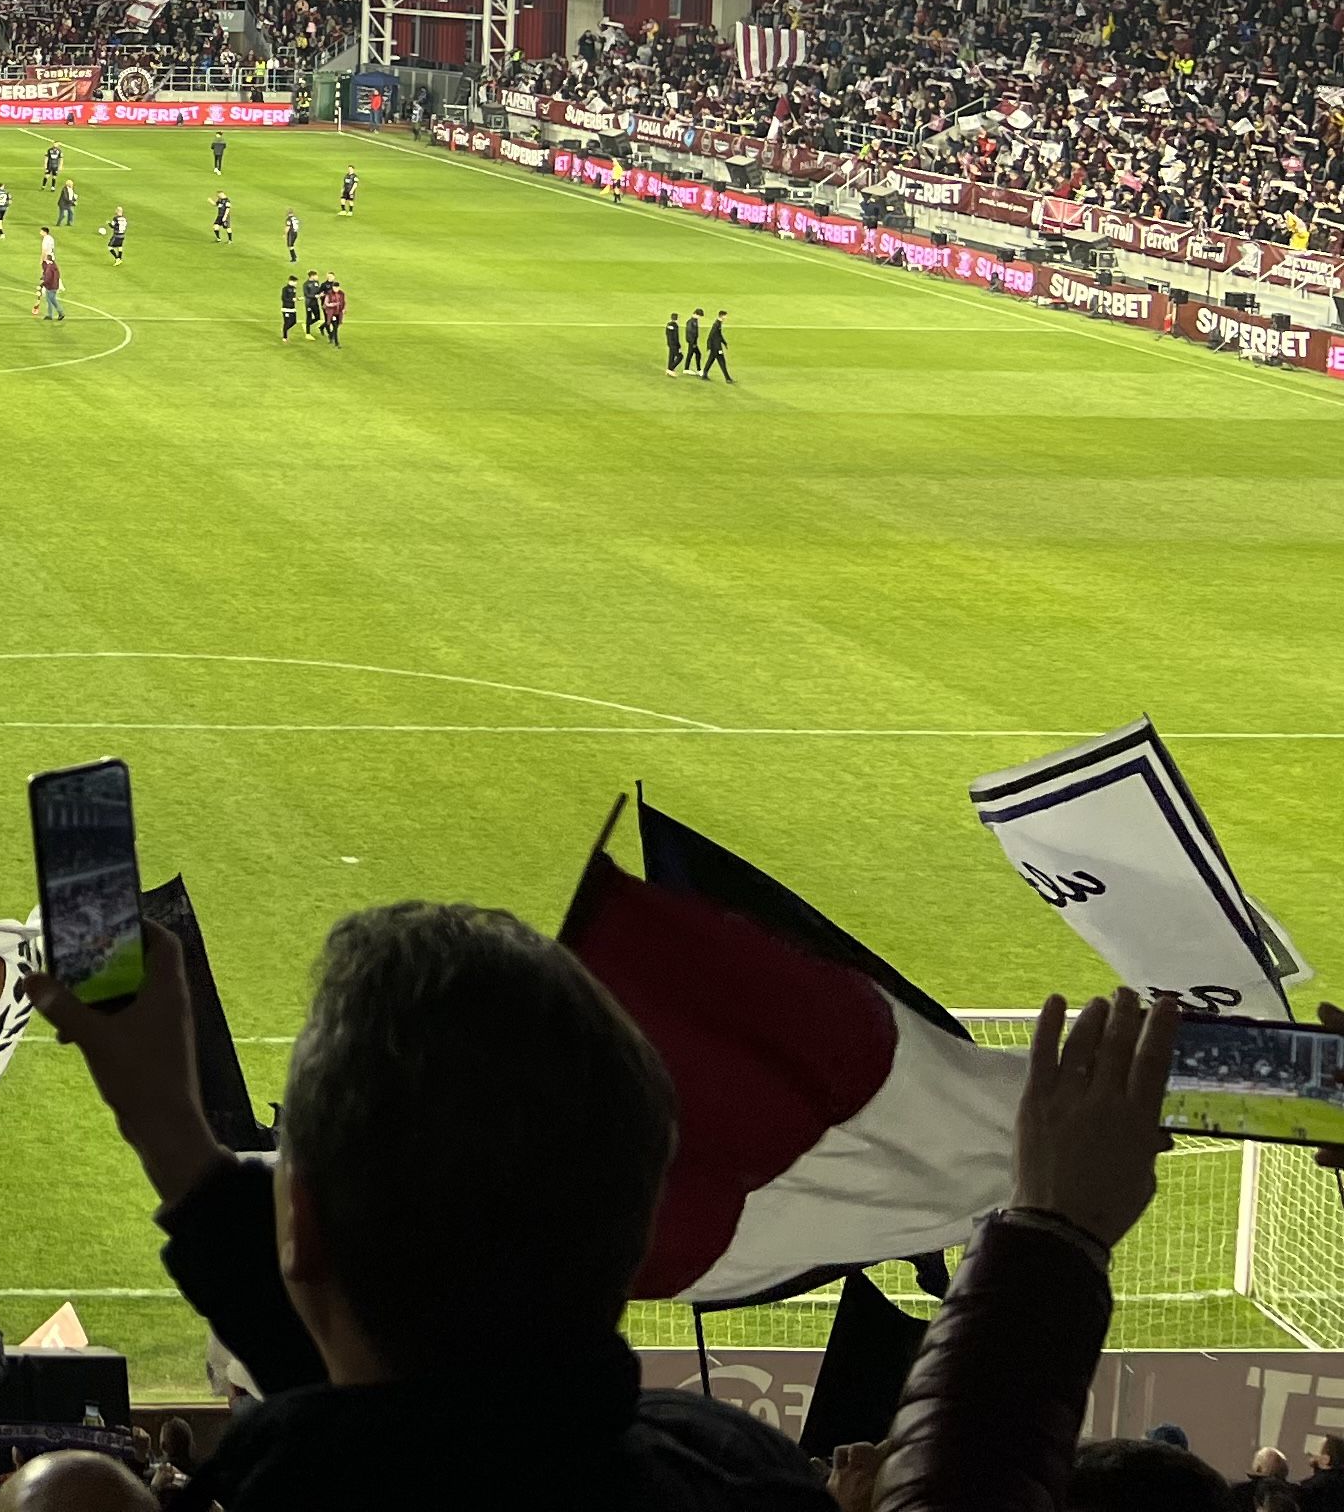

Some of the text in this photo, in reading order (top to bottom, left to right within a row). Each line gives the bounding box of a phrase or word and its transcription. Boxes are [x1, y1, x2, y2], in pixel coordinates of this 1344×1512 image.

[565, 105, 615, 130] SUPERBET
[637, 119, 661, 136] AQUA
[500, 139, 551, 167] SUPERBET
